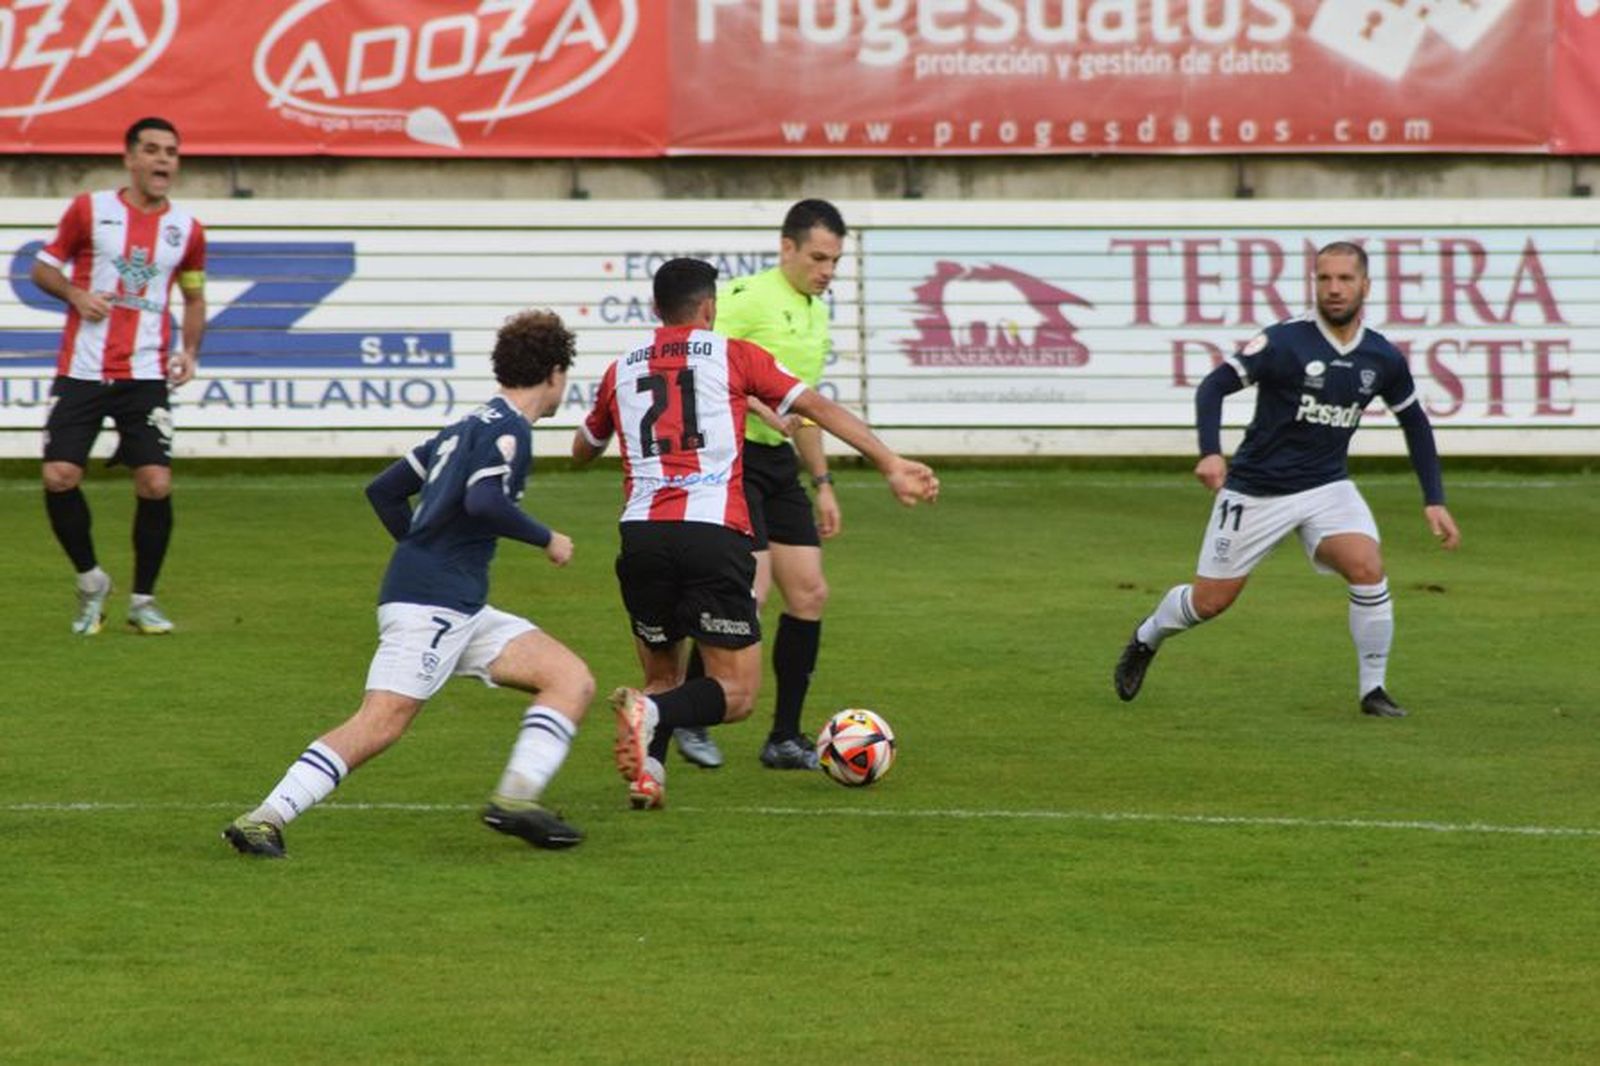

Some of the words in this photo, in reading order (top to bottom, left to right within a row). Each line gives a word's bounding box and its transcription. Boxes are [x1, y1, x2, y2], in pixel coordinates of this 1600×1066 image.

[268, 0, 608, 118] ADOZA
[1055, 54, 1073, 79] y
[1180, 48, 1211, 75] de
[1219, 49, 1291, 74] datos
[781, 112, 1432, 148] www.progesdatos.com
[360, 337, 447, 365] S.L.
[626, 346, 658, 366] JOEL
[660, 341, 713, 359] PRIEGO
[202, 378, 456, 414] ATILANO)
[634, 367, 705, 458] 21
[1218, 499, 1245, 532] 11
[431, 615, 453, 650] 7
